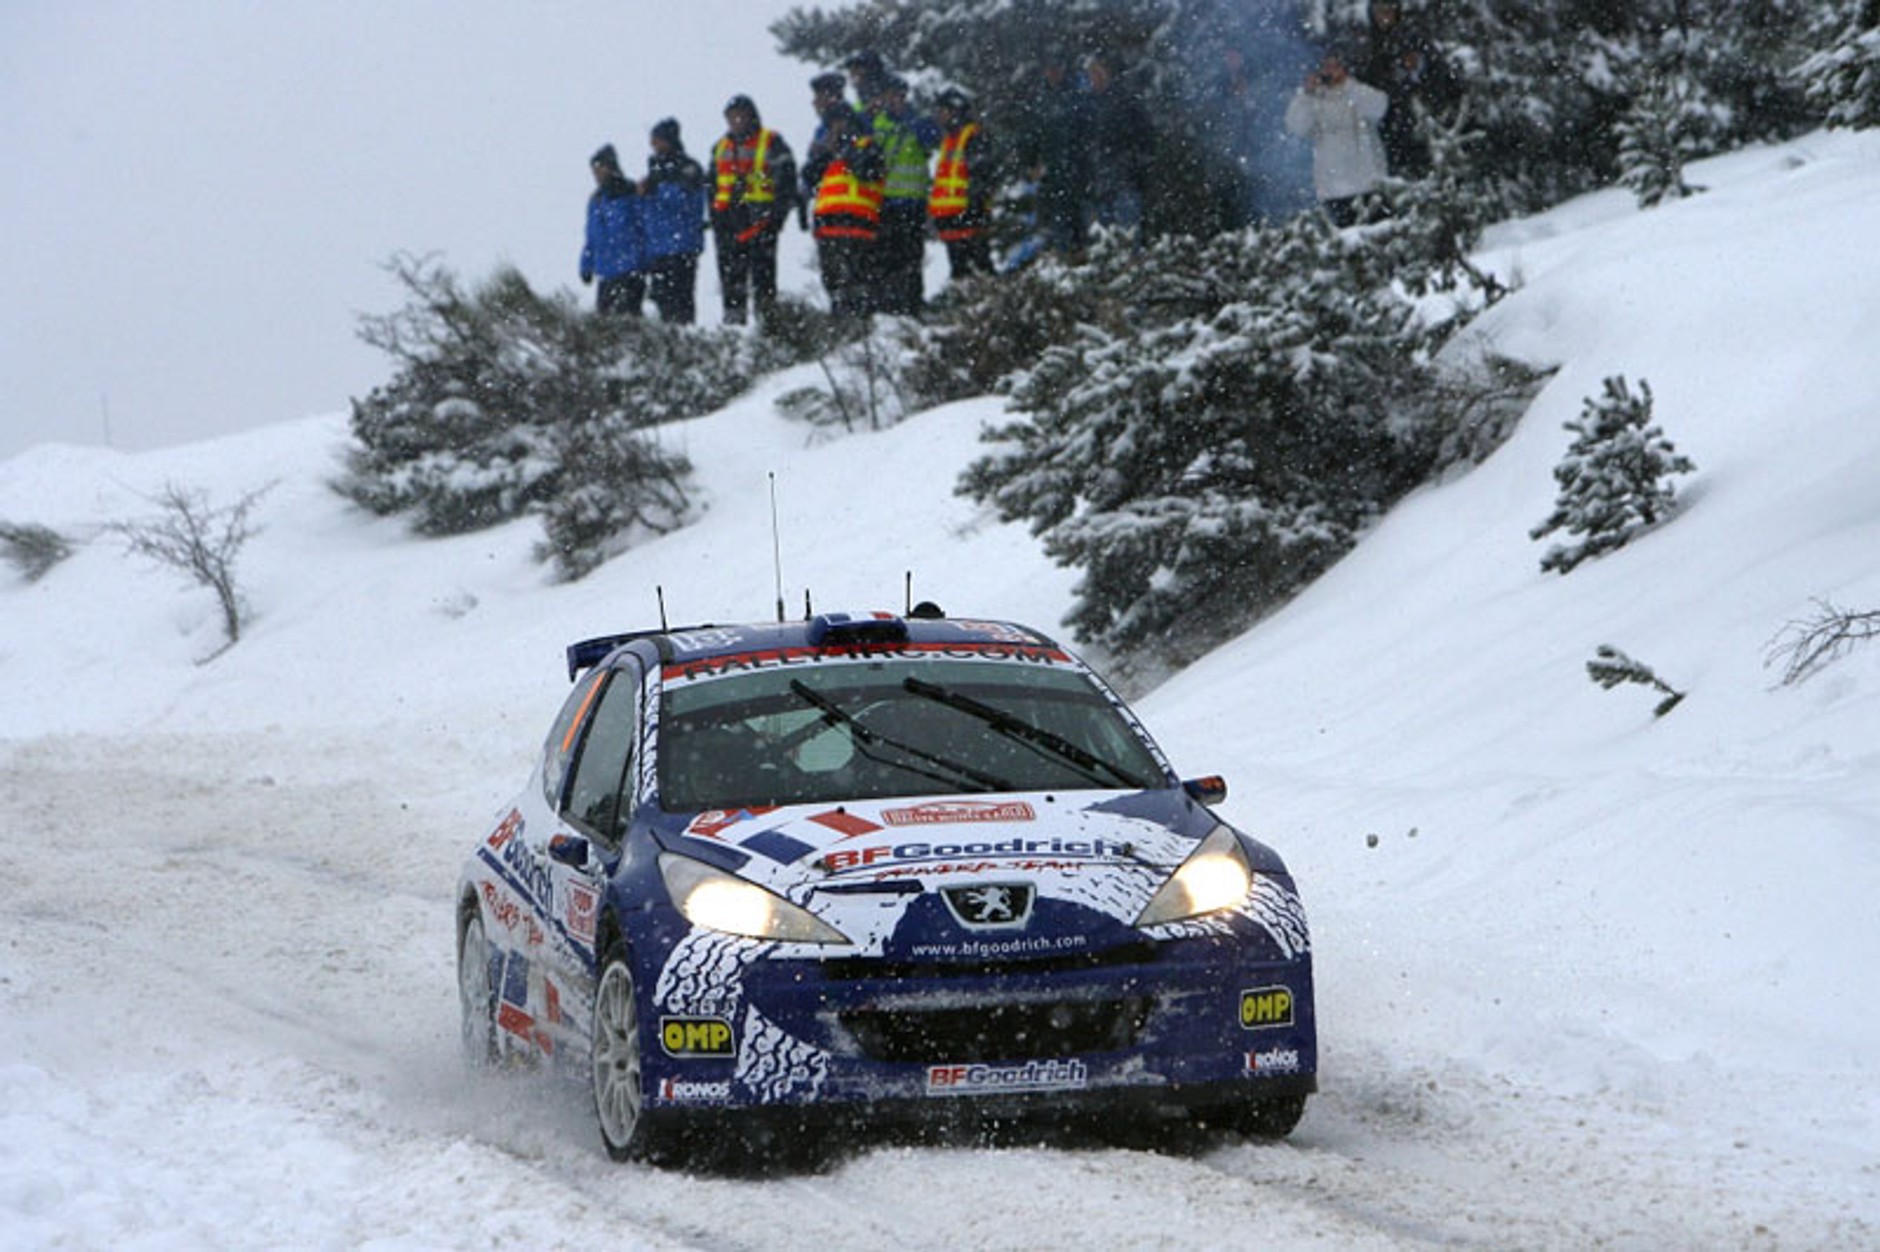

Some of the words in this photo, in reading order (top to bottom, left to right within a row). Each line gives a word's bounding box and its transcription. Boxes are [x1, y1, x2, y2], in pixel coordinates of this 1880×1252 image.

[824, 837, 1122, 869] BFGoodrich
[911, 934, 1087, 957] www.bfgoodrich.com
[1242, 992, 1291, 1023] OMP
[664, 1021, 731, 1050] OMP
[930, 1059, 1086, 1087] BFGoodrich
[658, 1075, 731, 1100] KRONOS
